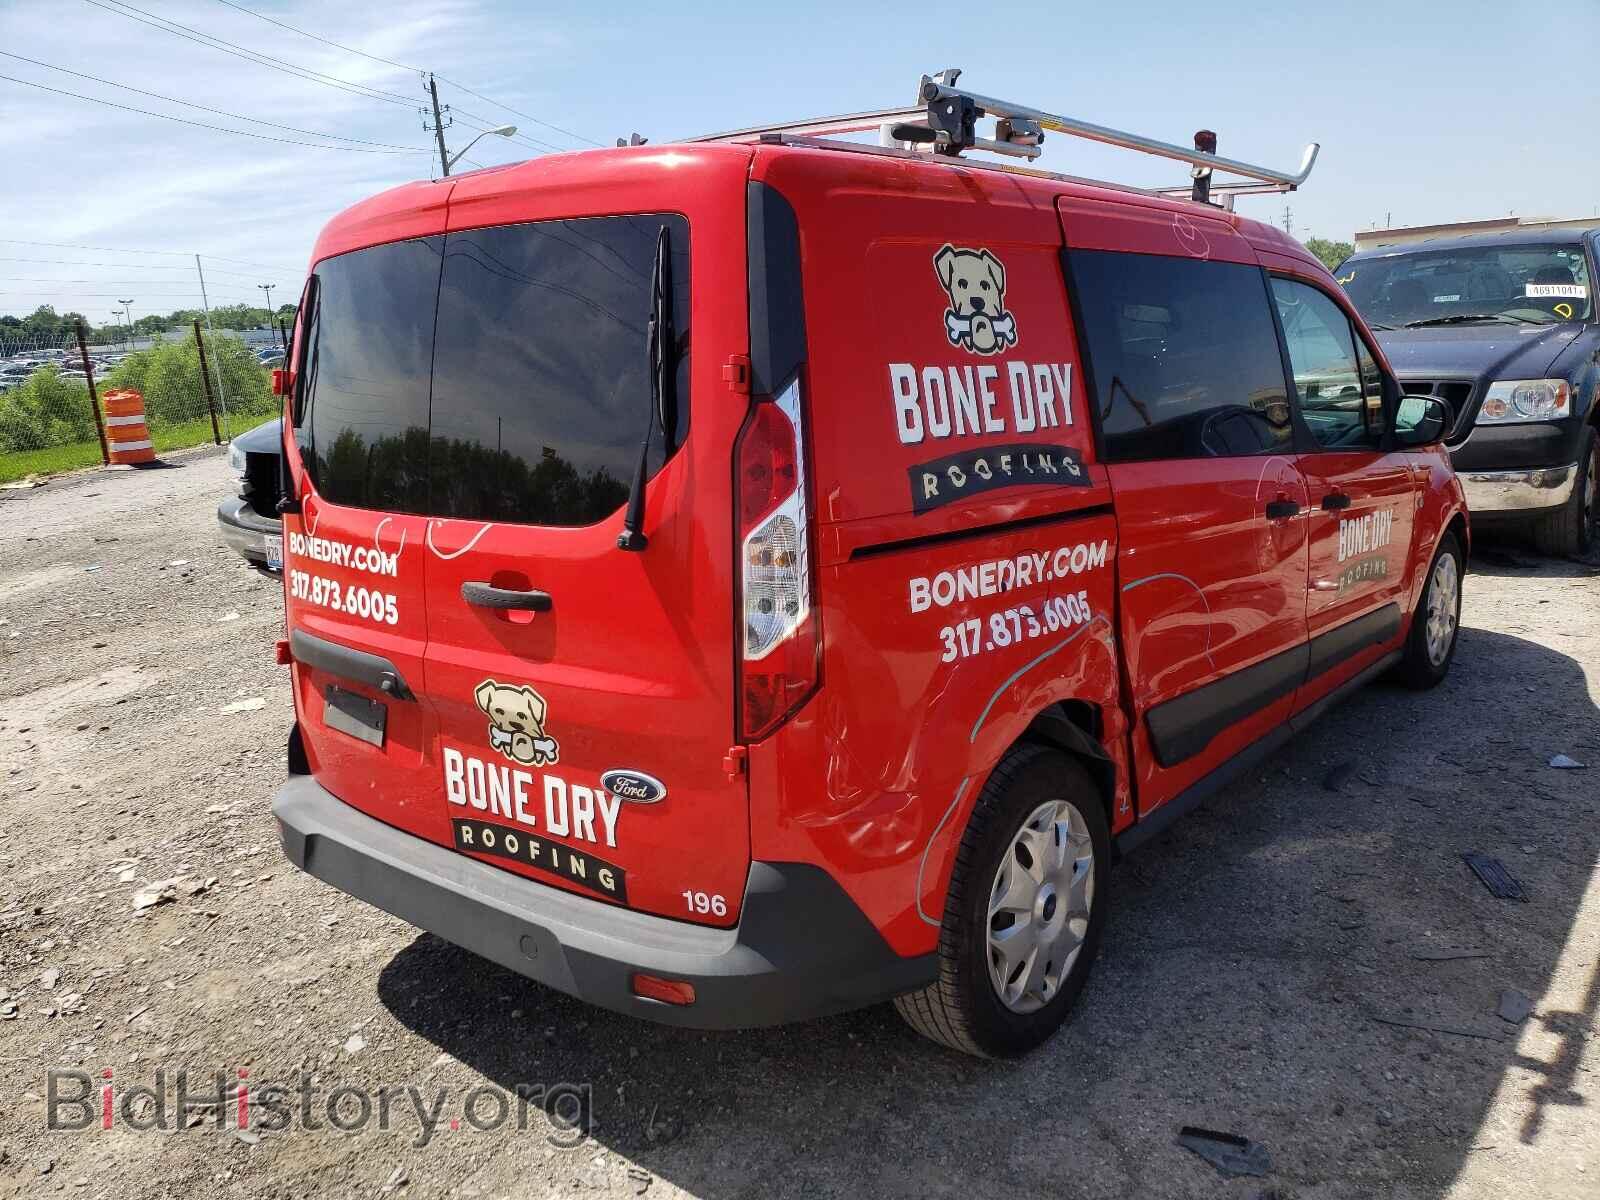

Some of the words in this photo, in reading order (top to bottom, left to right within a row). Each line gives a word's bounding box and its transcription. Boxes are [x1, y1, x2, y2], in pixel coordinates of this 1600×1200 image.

[888, 362, 1005, 444] BONE
[1006, 360, 1072, 433] DRY
[922, 454, 1081, 500] ROOFING
[289, 531, 397, 576] BONEDRY.COM
[1338, 515, 1371, 562] BONE
[1371, 508, 1393, 551] DRY
[290, 568, 399, 625] 317.873.6005
[909, 539, 1108, 613] BONEDRY.COM
[1339, 559, 1386, 593] ROOFING
[939, 590, 1092, 662] 317.873.6005
[443, 747, 536, 826] BONE
[543, 773, 622, 848] DRY
[610, 776, 648, 799] Ford
[461, 825, 617, 892] ROOFING
[682, 890, 728, 918] 196
